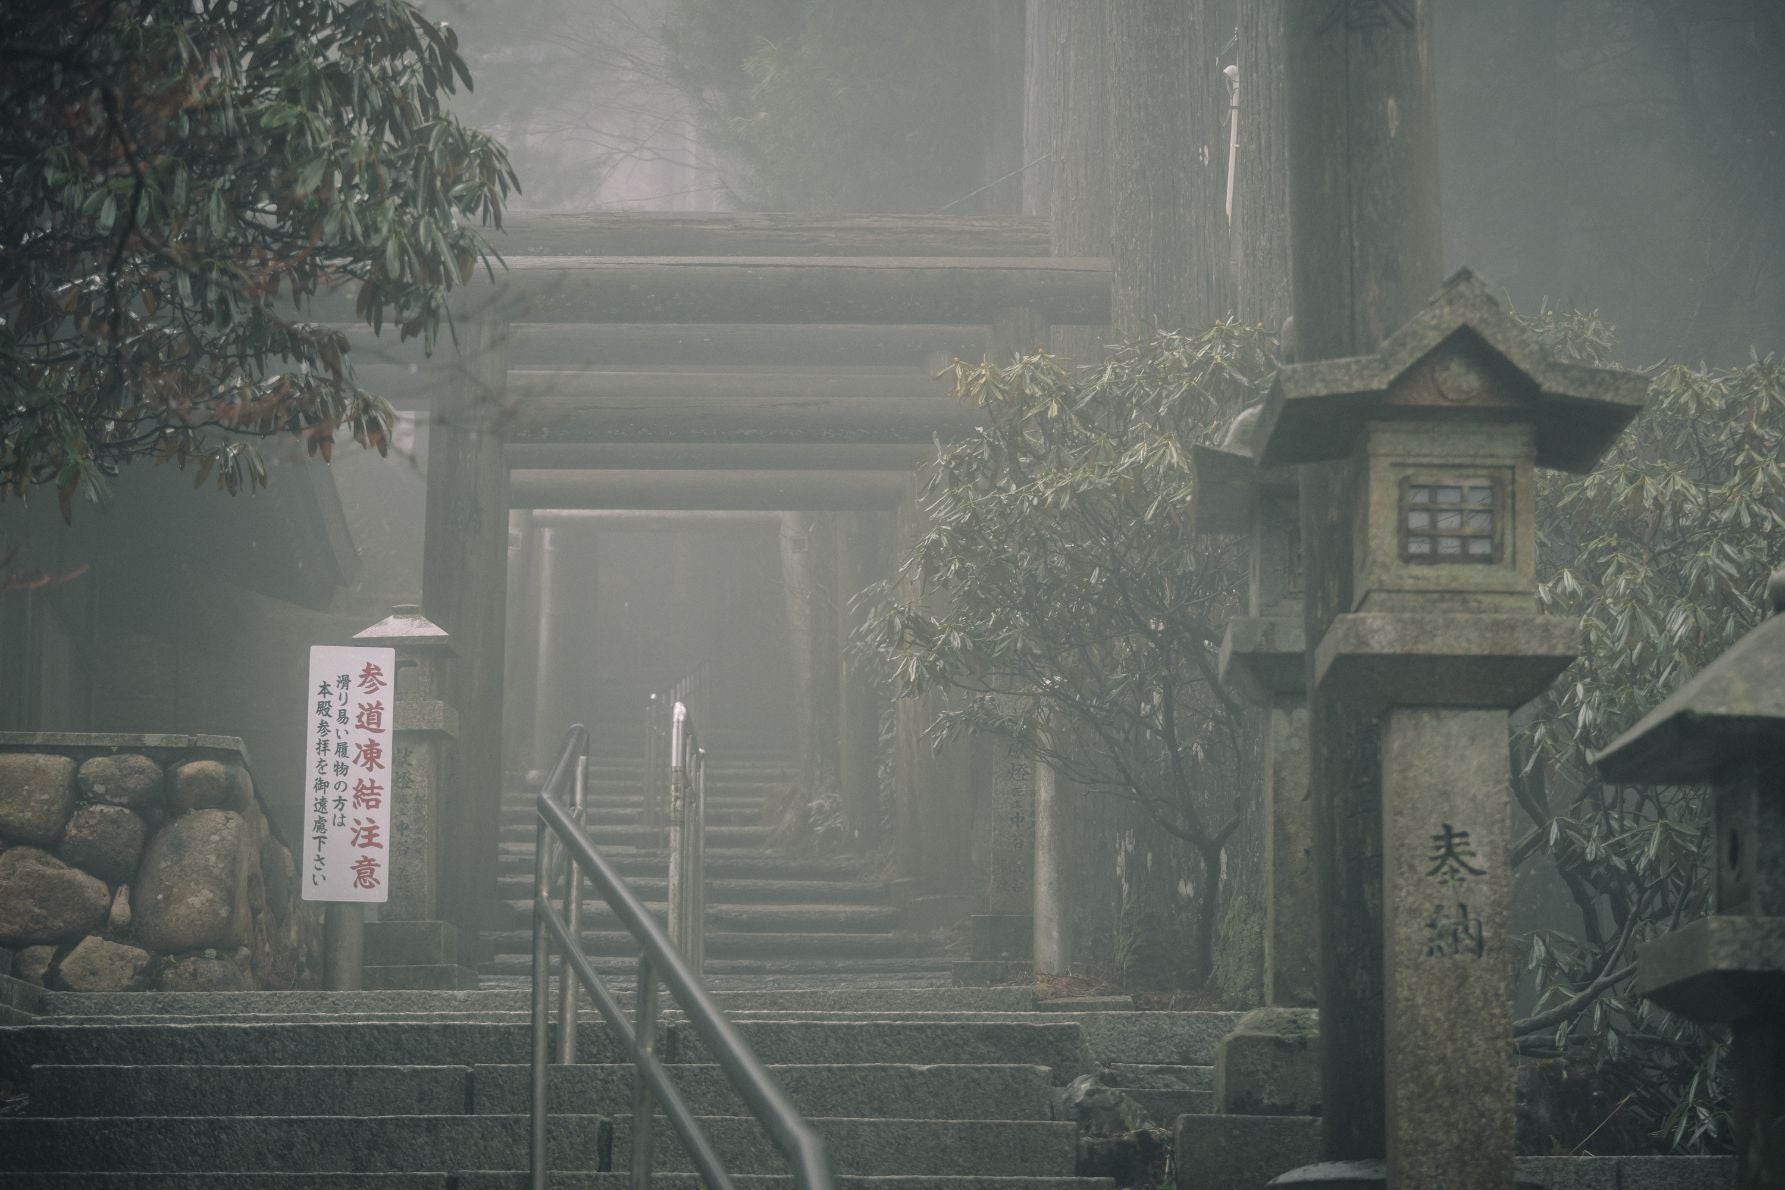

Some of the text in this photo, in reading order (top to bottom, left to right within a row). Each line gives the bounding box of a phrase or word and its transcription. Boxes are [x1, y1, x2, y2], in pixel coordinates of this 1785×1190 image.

[311, 680, 334, 887] 本殿参拝を御遠慮下さい
[332, 674, 352, 828] 滑り易い履物の方は
[349, 661, 388, 889] 参道凍結注意
[1425, 823, 1487, 959] 奉納
